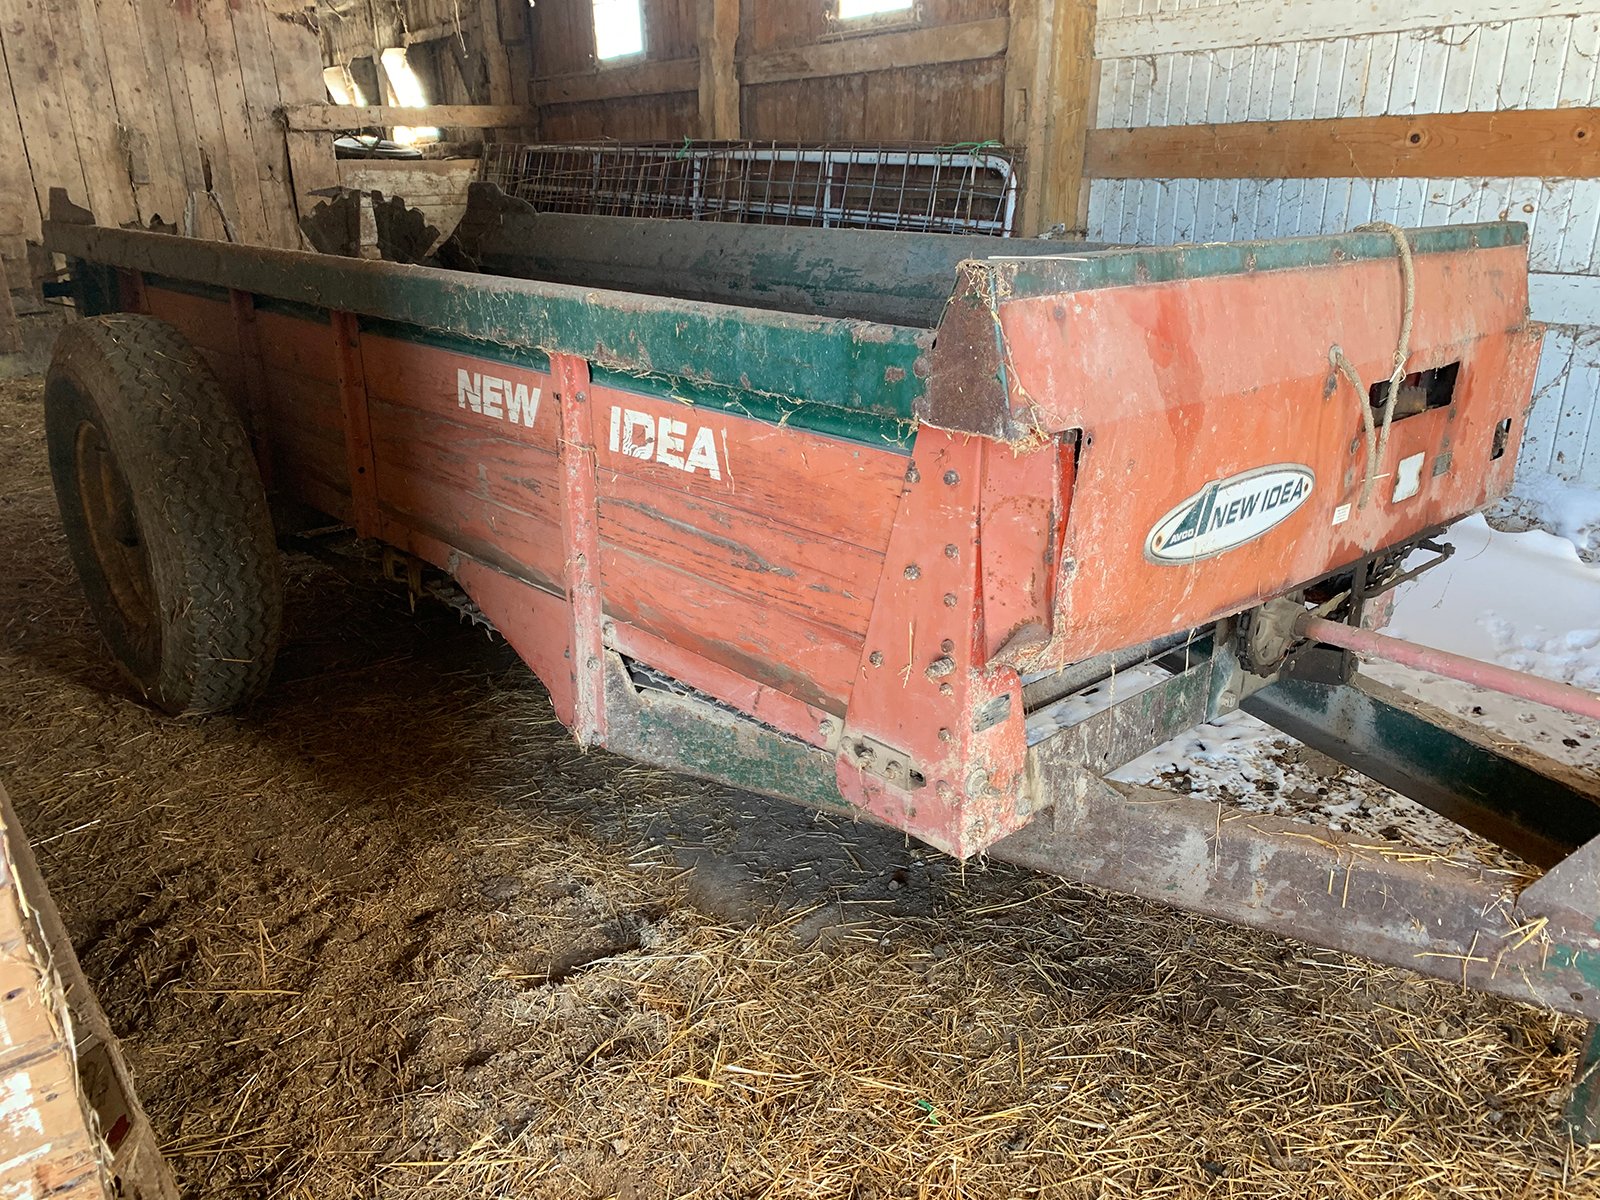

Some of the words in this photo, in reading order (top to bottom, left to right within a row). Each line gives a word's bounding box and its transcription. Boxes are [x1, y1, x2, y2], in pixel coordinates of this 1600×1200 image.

[457, 368, 541, 428] NEW
[608, 405, 721, 481] IDEA
[1209, 491, 1262, 532] NEW
[1260, 477, 1304, 513] IDEA
[1169, 528, 1194, 545] AVCO
